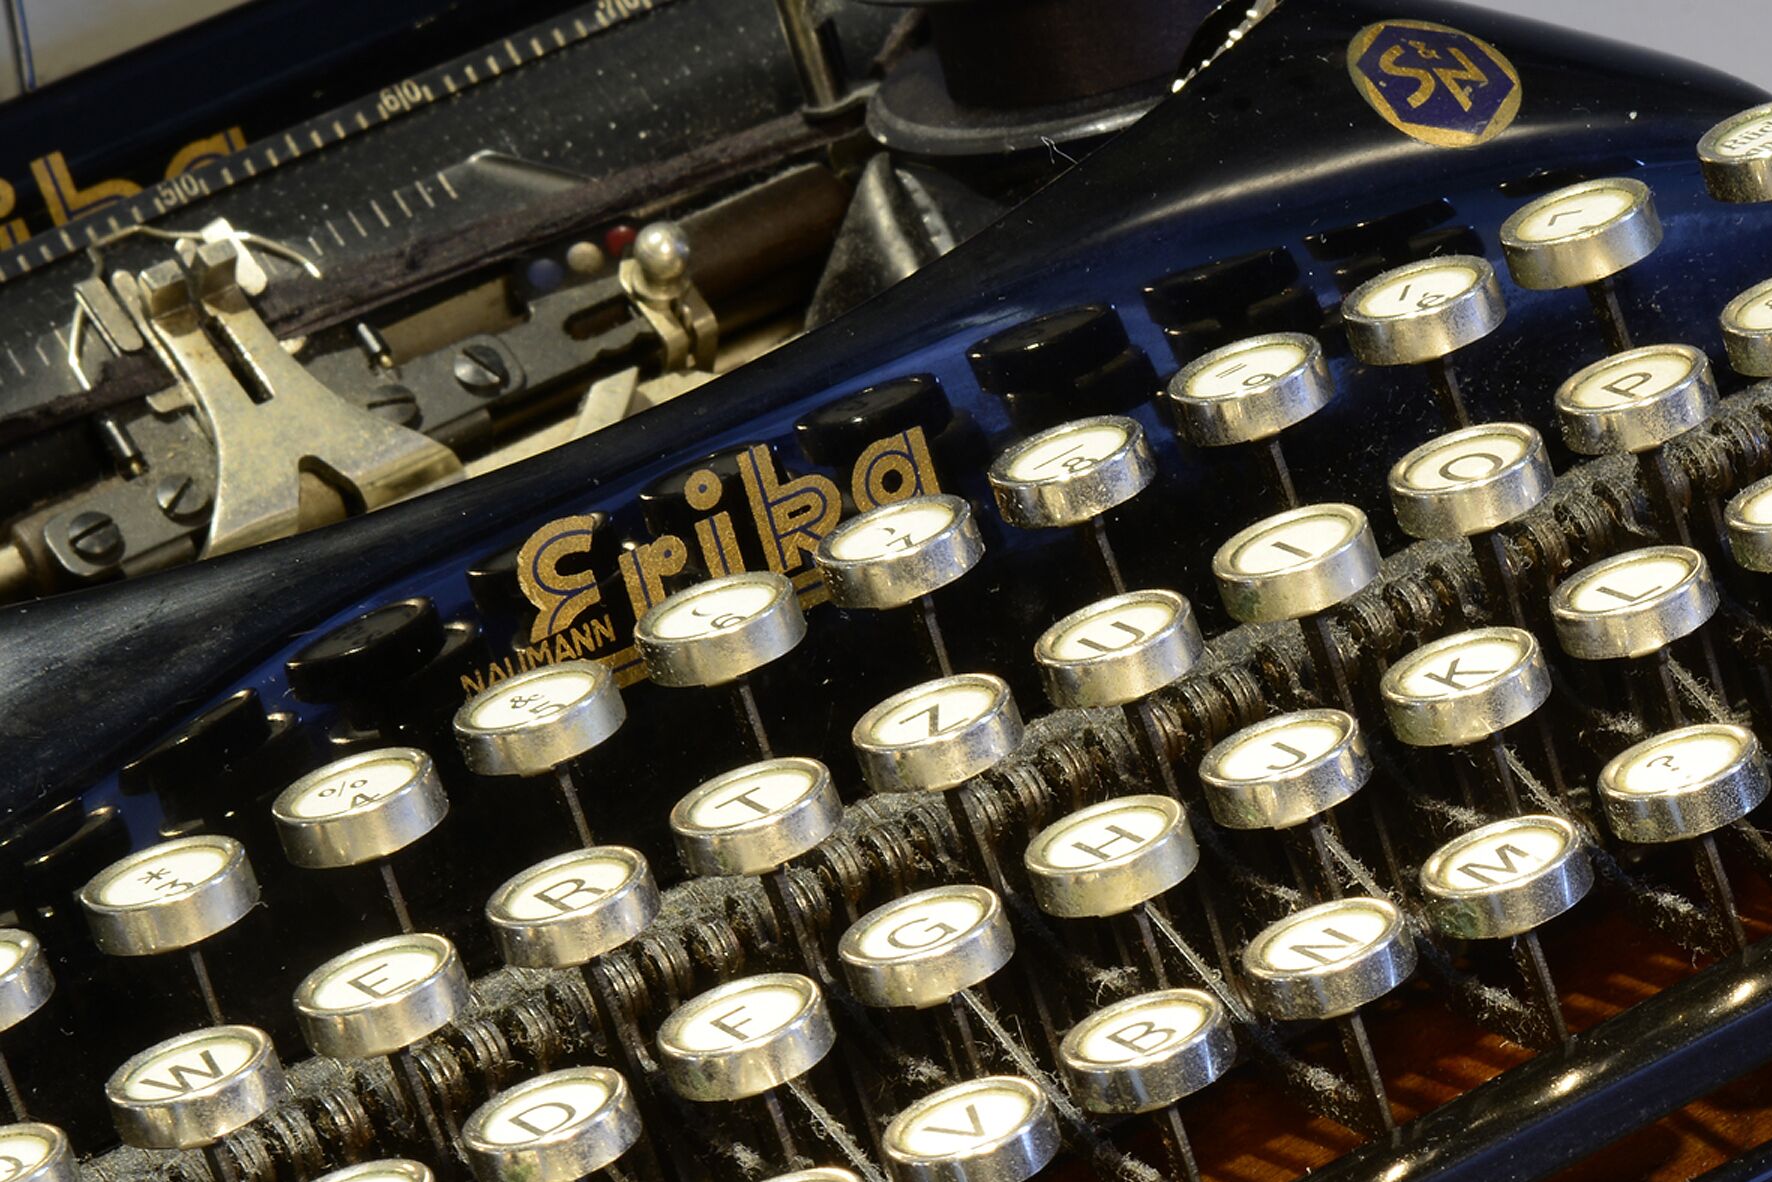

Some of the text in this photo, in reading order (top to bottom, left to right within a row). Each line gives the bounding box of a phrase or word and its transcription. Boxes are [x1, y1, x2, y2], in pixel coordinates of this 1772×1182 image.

[1601, 372, 1652, 398] P
[1062, 457, 1098, 473] 8
[1440, 453, 1503, 481] O
[1271, 541, 1313, 559] I
[1597, 584, 1663, 602] L
[1077, 621, 1146, 651] U
[1423, 657, 1501, 691] K
[900, 703, 969, 739] Z
[1266, 741, 1308, 772] J
[714, 786, 777, 814] T
[1072, 825, 1145, 861] H
[1457, 843, 1533, 887] M
[534, 879, 604, 911] R
[887, 917, 958, 950] G
[1289, 928, 1361, 967] N
[348, 963, 416, 999] E
[709, 1006, 758, 1040] F
[1106, 1021, 1177, 1055] B
[139, 1050, 222, 1090] W
[509, 1102, 577, 1137] D
[922, 1105, 985, 1138] V
